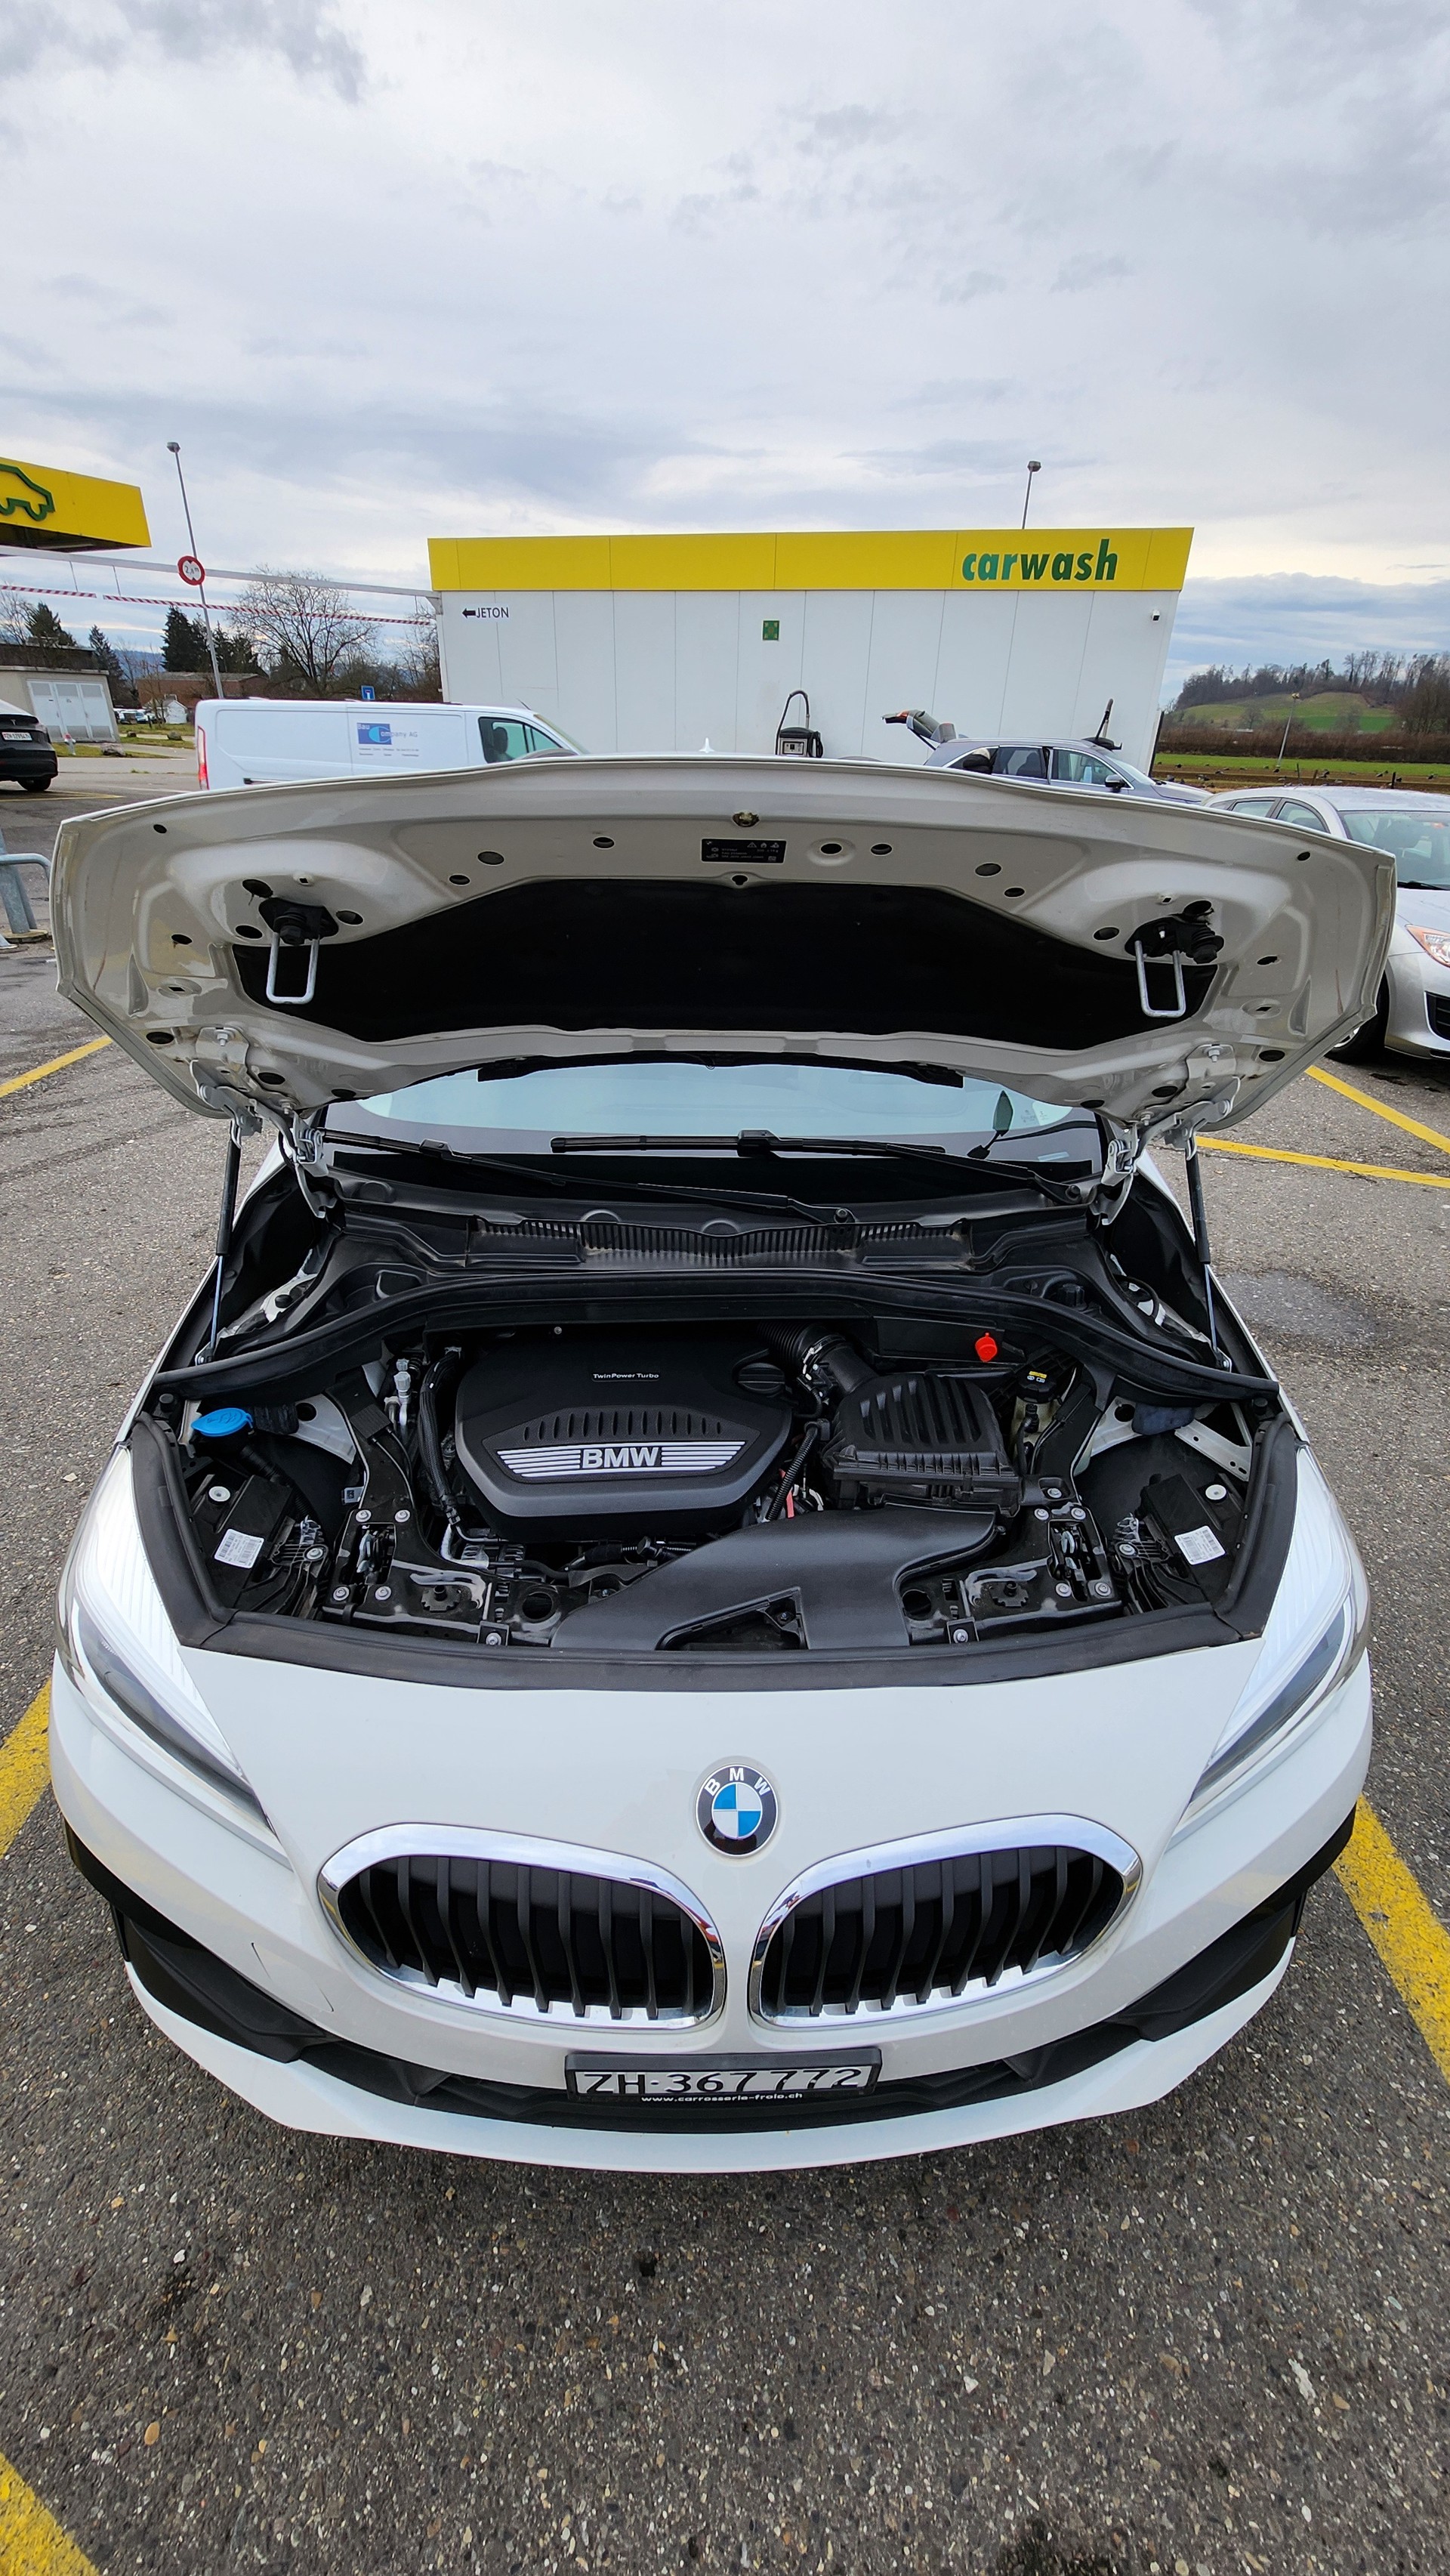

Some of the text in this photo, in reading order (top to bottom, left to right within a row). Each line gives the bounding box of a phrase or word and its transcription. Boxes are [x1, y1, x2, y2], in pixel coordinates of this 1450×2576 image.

[962, 538, 1118, 581] carwash
[476, 607, 510, 619] JETON
[582, 1447, 659, 1469] BMW
[704, 1767, 771, 1797] BMW
